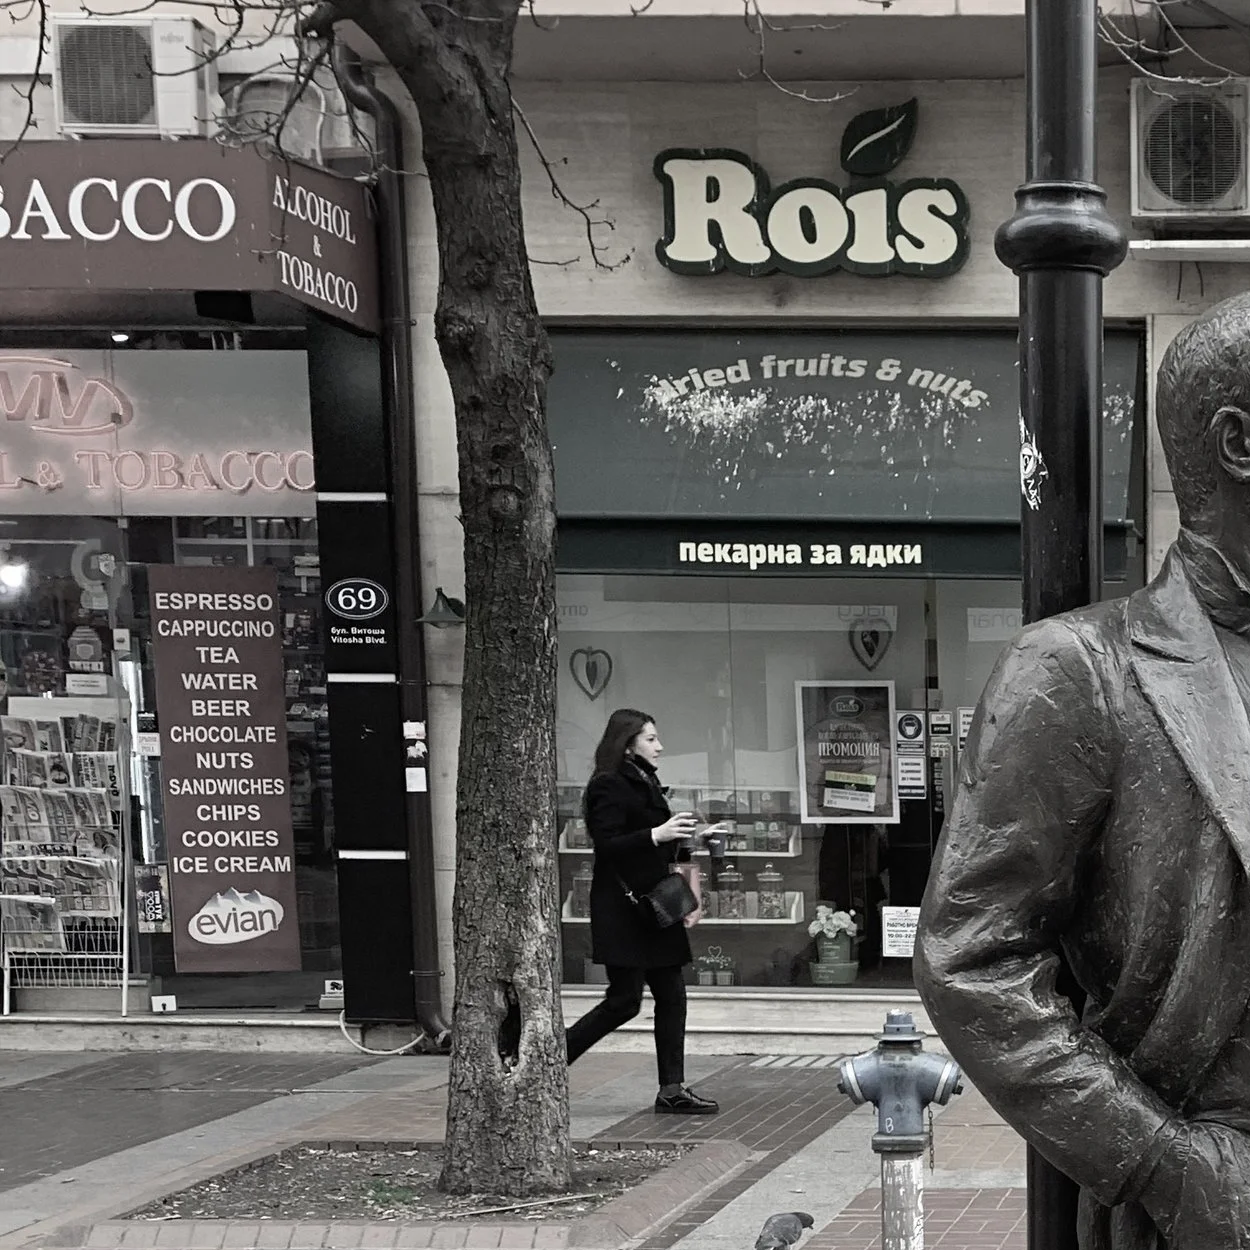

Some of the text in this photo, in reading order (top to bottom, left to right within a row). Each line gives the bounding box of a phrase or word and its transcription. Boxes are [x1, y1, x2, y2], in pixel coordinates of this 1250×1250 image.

[0, 177, 236, 242] ACCO
[273, 174, 356, 245] ALCOHOL
[662, 158, 960, 265] Rois
[313, 234, 323, 258] &
[277, 250, 358, 313] TOBACCO
[655, 353, 989, 408] dried fruits & nuts
[38, 460, 63, 490] &
[74, 449, 316, 492] TOBACCO
[679, 541, 922, 571] пекарна за ядки
[155, 592, 273, 611] ESPRESSO
[337, 587, 377, 611] 69
[157, 619, 275, 638] CAPPUCCINO
[350, 626, 386, 635] Витоша
[331, 635, 388, 644] Vitosha Blvd.
[195, 646, 240, 664] TEA
[181, 673, 258, 690] WATER
[191, 699, 251, 717] BEER
[170, 726, 277, 743] CHOCOLATE
[818, 742, 880, 758] ПРОМОЦИЯ
[195, 752, 254, 769] NUTS
[169, 778, 285, 796] SANDWICHES
[196, 804, 262, 821] CHIPS
[181, 830, 280, 847] COOKIES
[173, 856, 292, 873] ICE CREAM
[195, 907, 278, 936] evian
